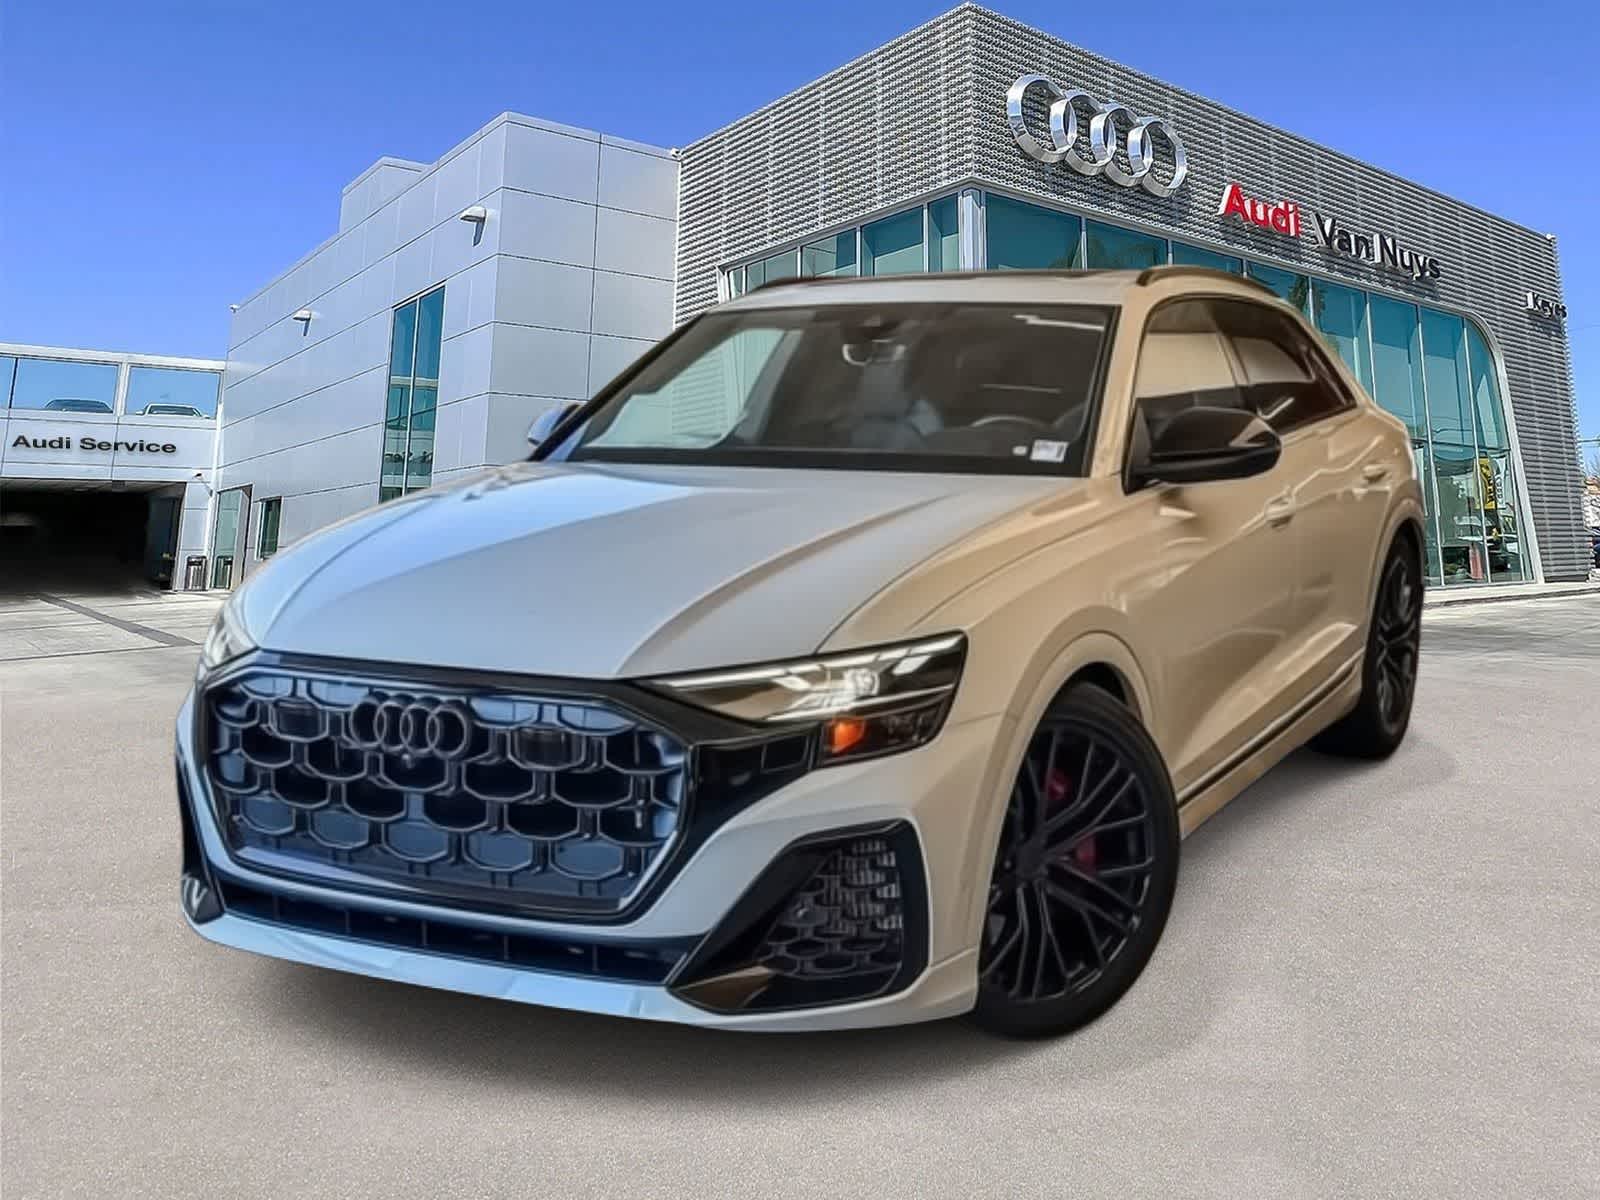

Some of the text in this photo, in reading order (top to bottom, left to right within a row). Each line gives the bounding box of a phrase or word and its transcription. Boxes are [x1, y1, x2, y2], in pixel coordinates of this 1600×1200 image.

[1220, 183, 1441, 280] Audi Van Nuys
[12, 435, 177, 453] Audi Service
